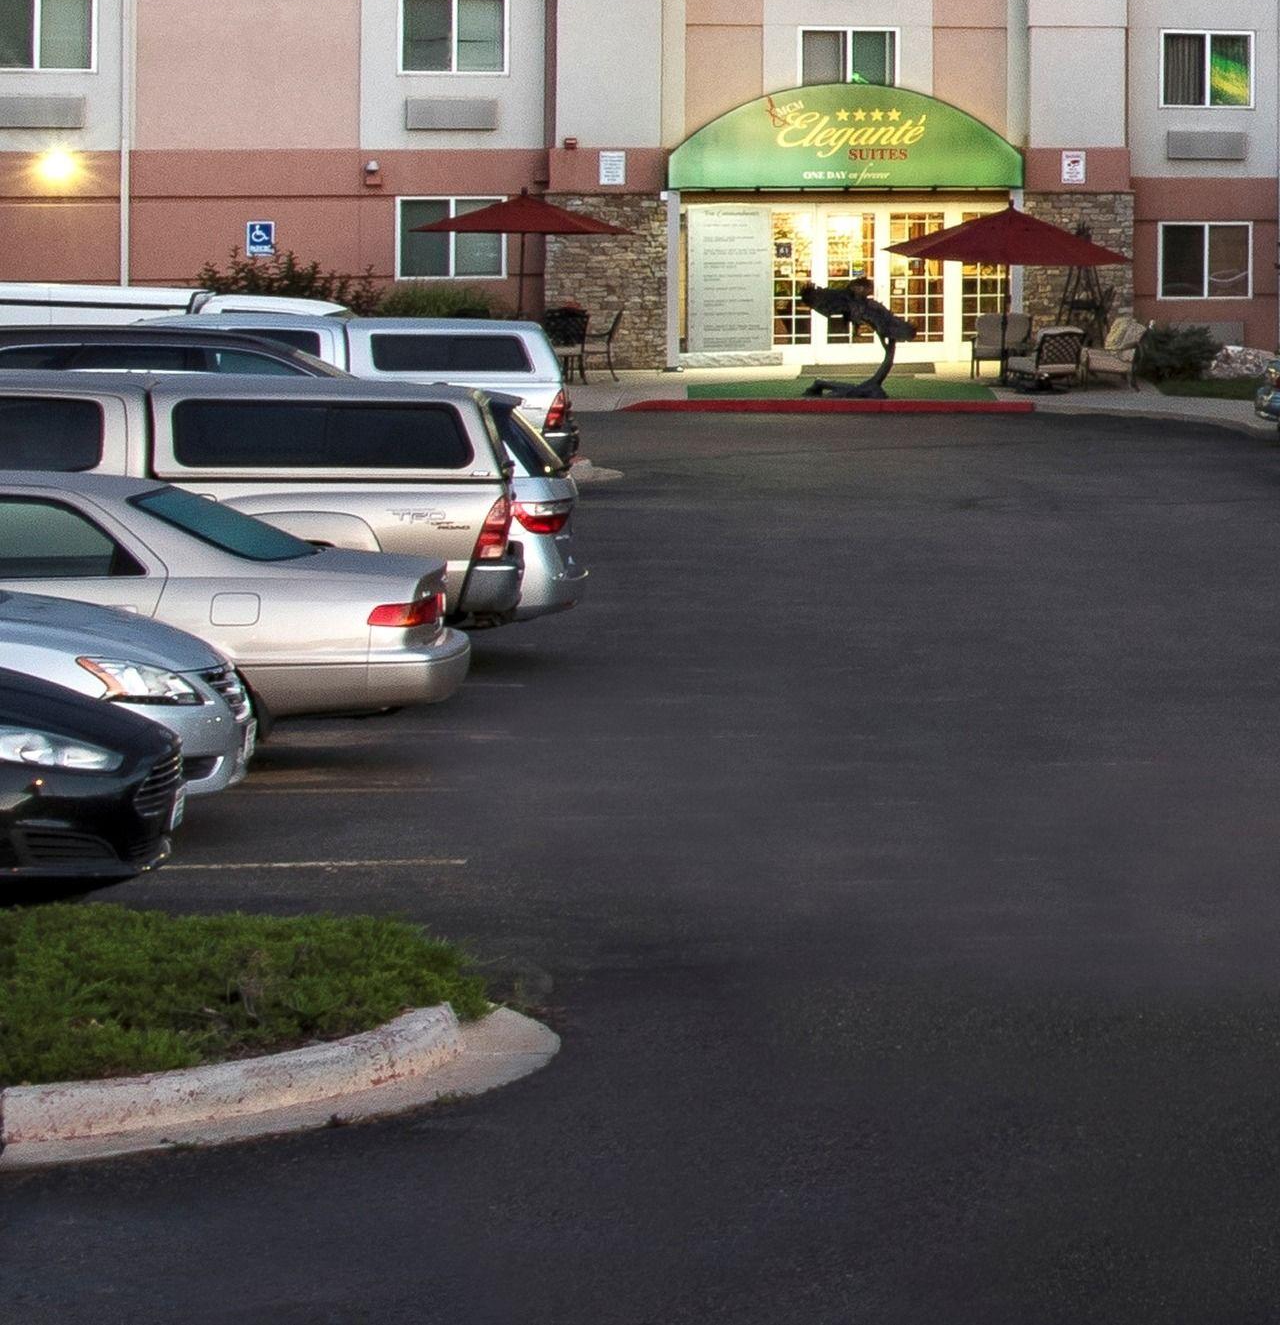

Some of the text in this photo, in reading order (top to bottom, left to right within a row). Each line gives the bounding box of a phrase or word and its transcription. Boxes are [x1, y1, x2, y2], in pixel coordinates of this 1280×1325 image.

[775, 99, 805, 118] MCM
[776, 111, 927, 158] Eleganté
[848, 148, 908, 160] SUITES
[803, 170, 824, 180] ONE
[826, 170, 847, 180] DAY
